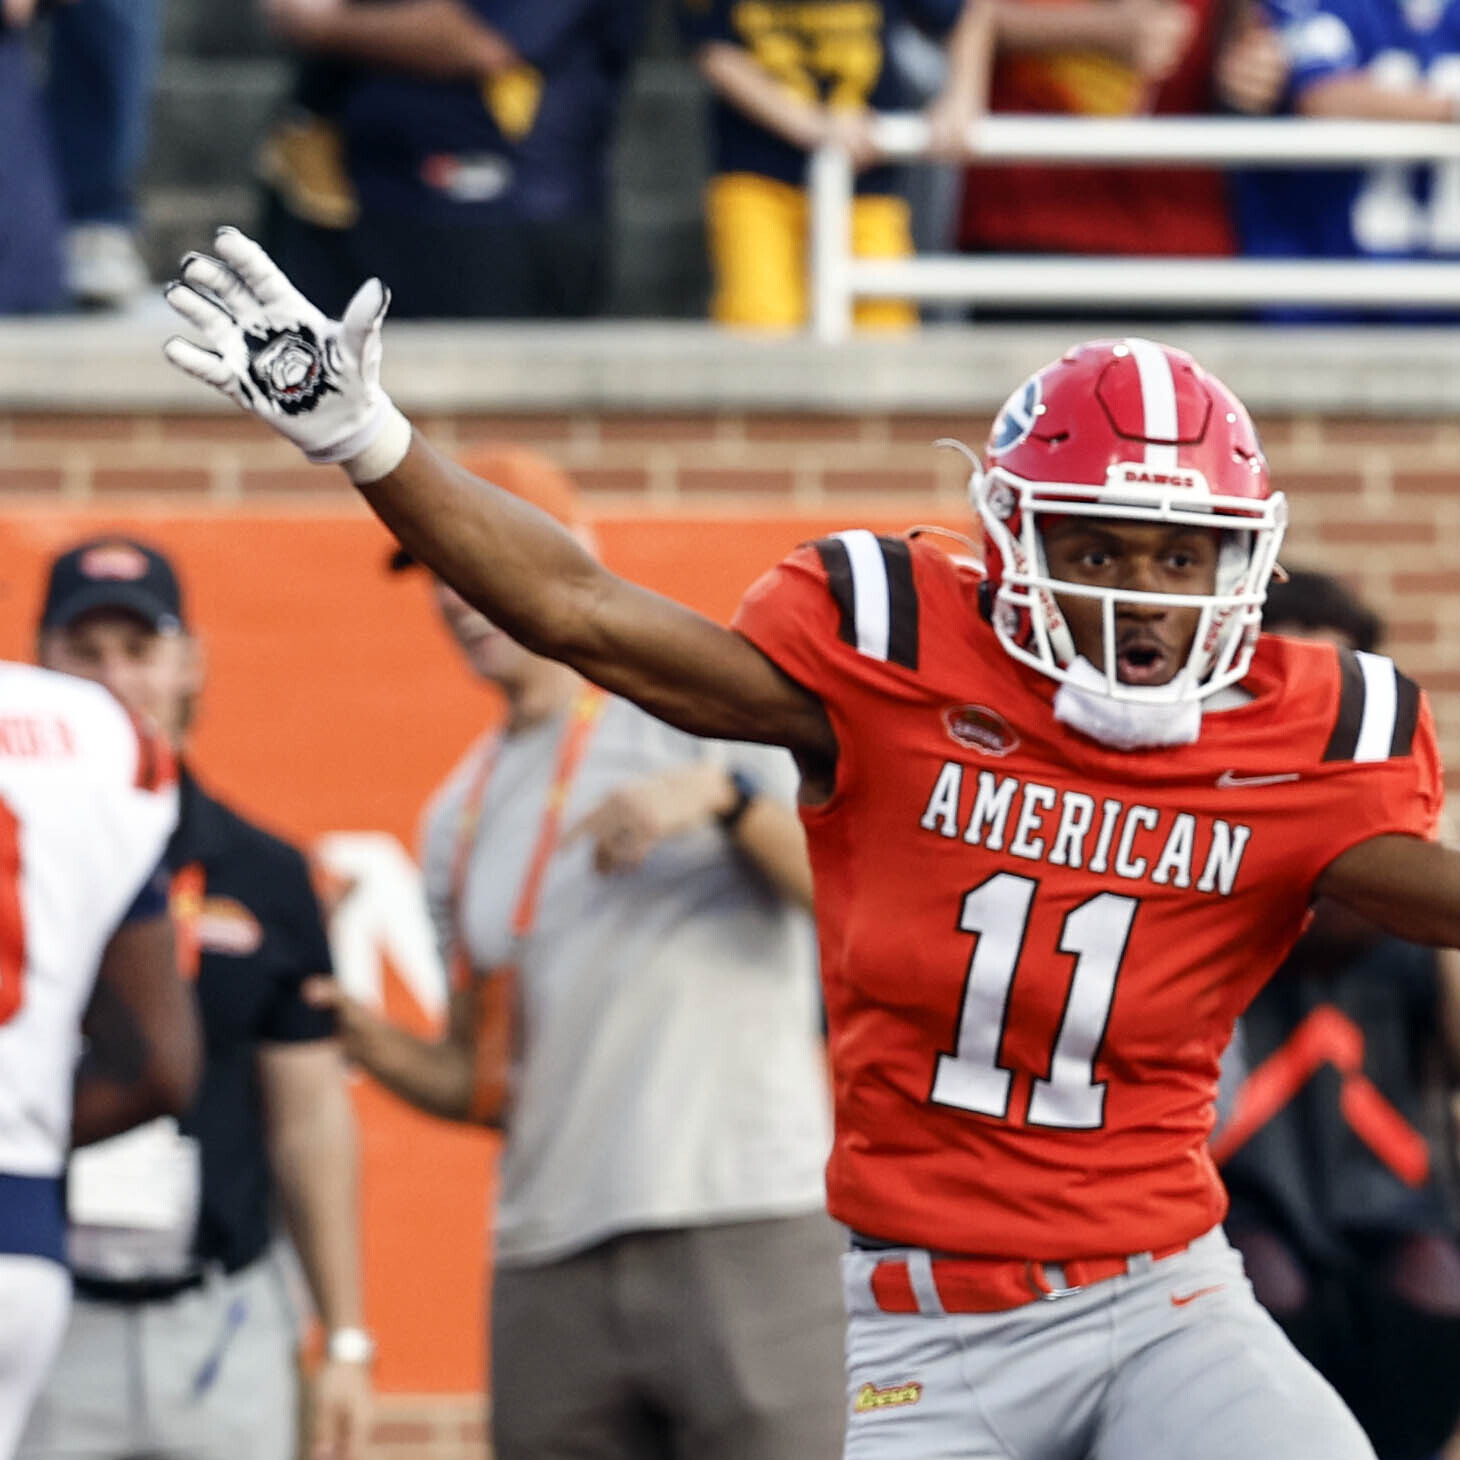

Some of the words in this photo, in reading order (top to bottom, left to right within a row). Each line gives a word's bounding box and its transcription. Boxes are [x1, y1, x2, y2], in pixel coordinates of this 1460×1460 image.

[1124, 470, 1195, 488] DAWGS
[921, 760, 1250, 896] AMERICAN
[930, 871, 1140, 1130] 11
